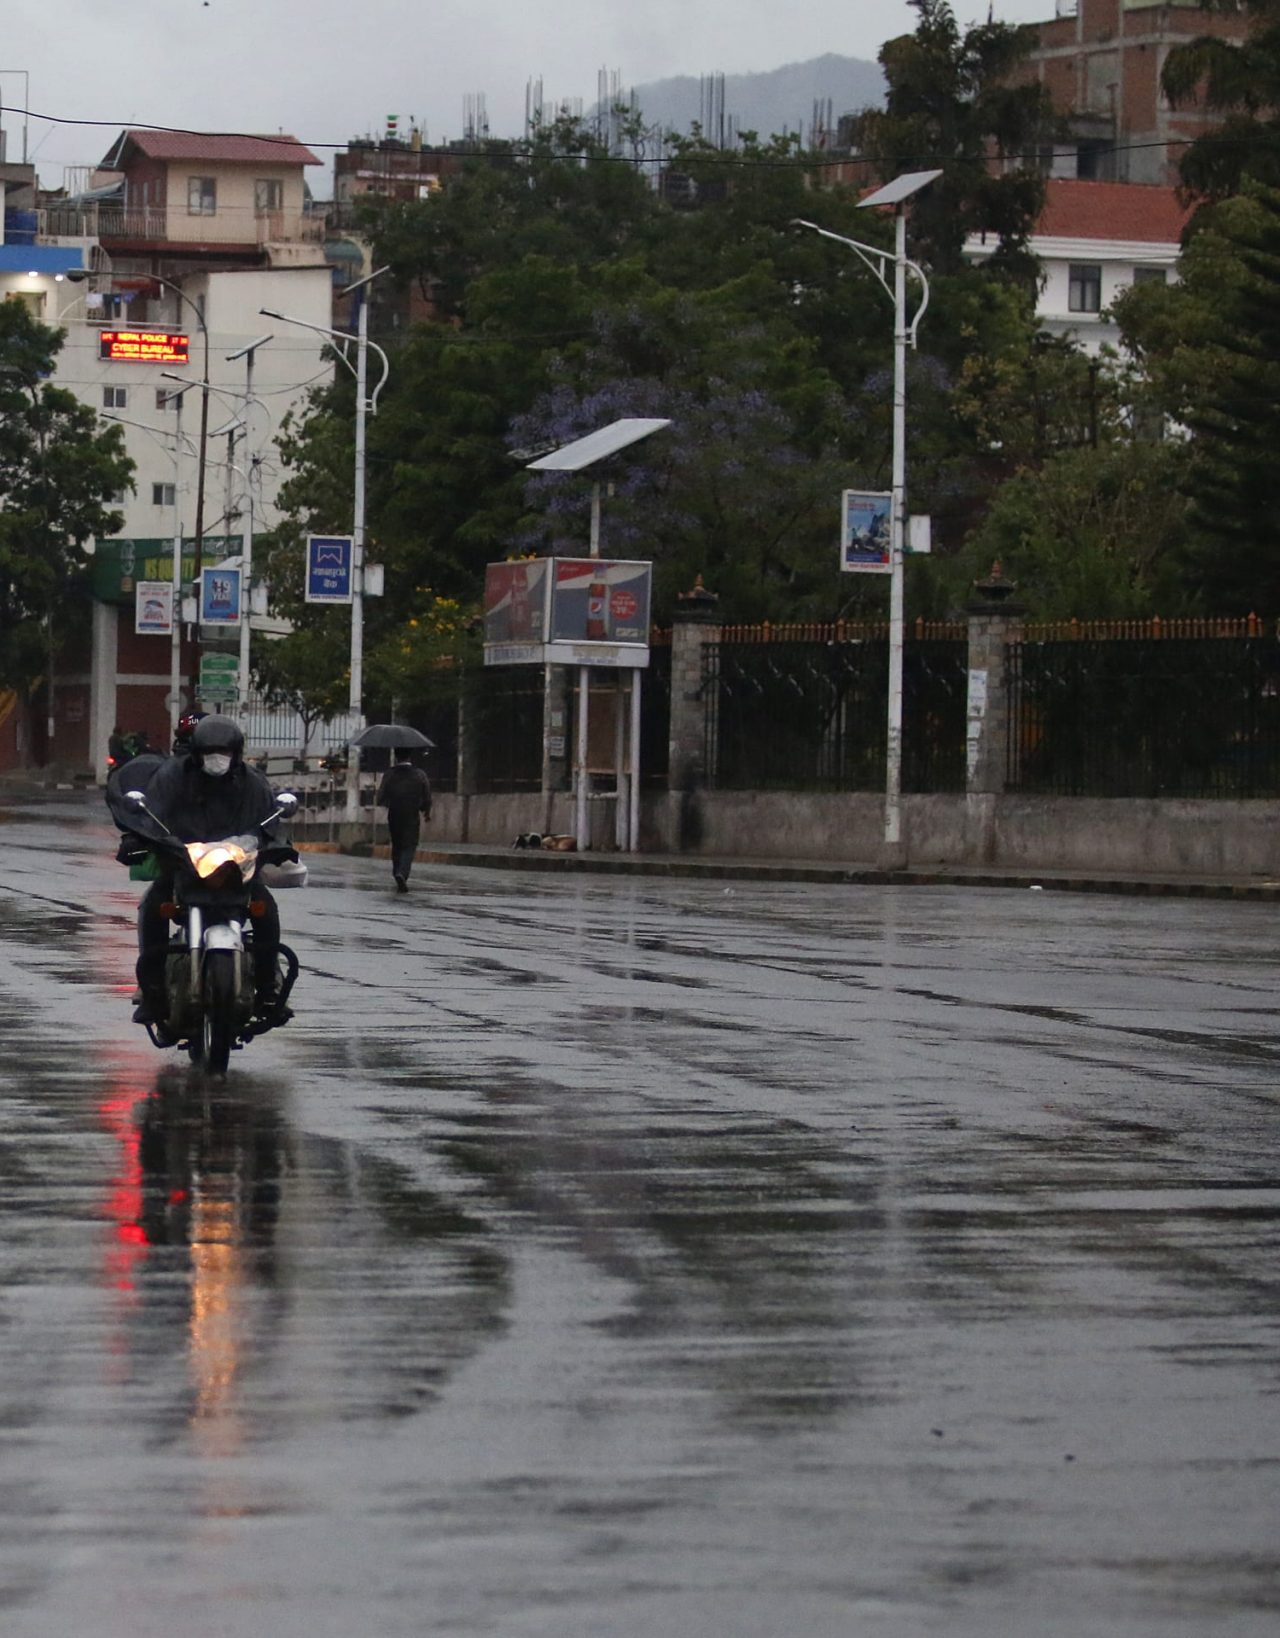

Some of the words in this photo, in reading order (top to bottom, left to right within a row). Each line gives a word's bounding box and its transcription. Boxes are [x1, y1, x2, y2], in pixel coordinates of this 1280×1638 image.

[141, 334, 167, 343] POLICE
[112, 343, 139, 351] CYBER
[141, 344, 174, 353] BUREAU
